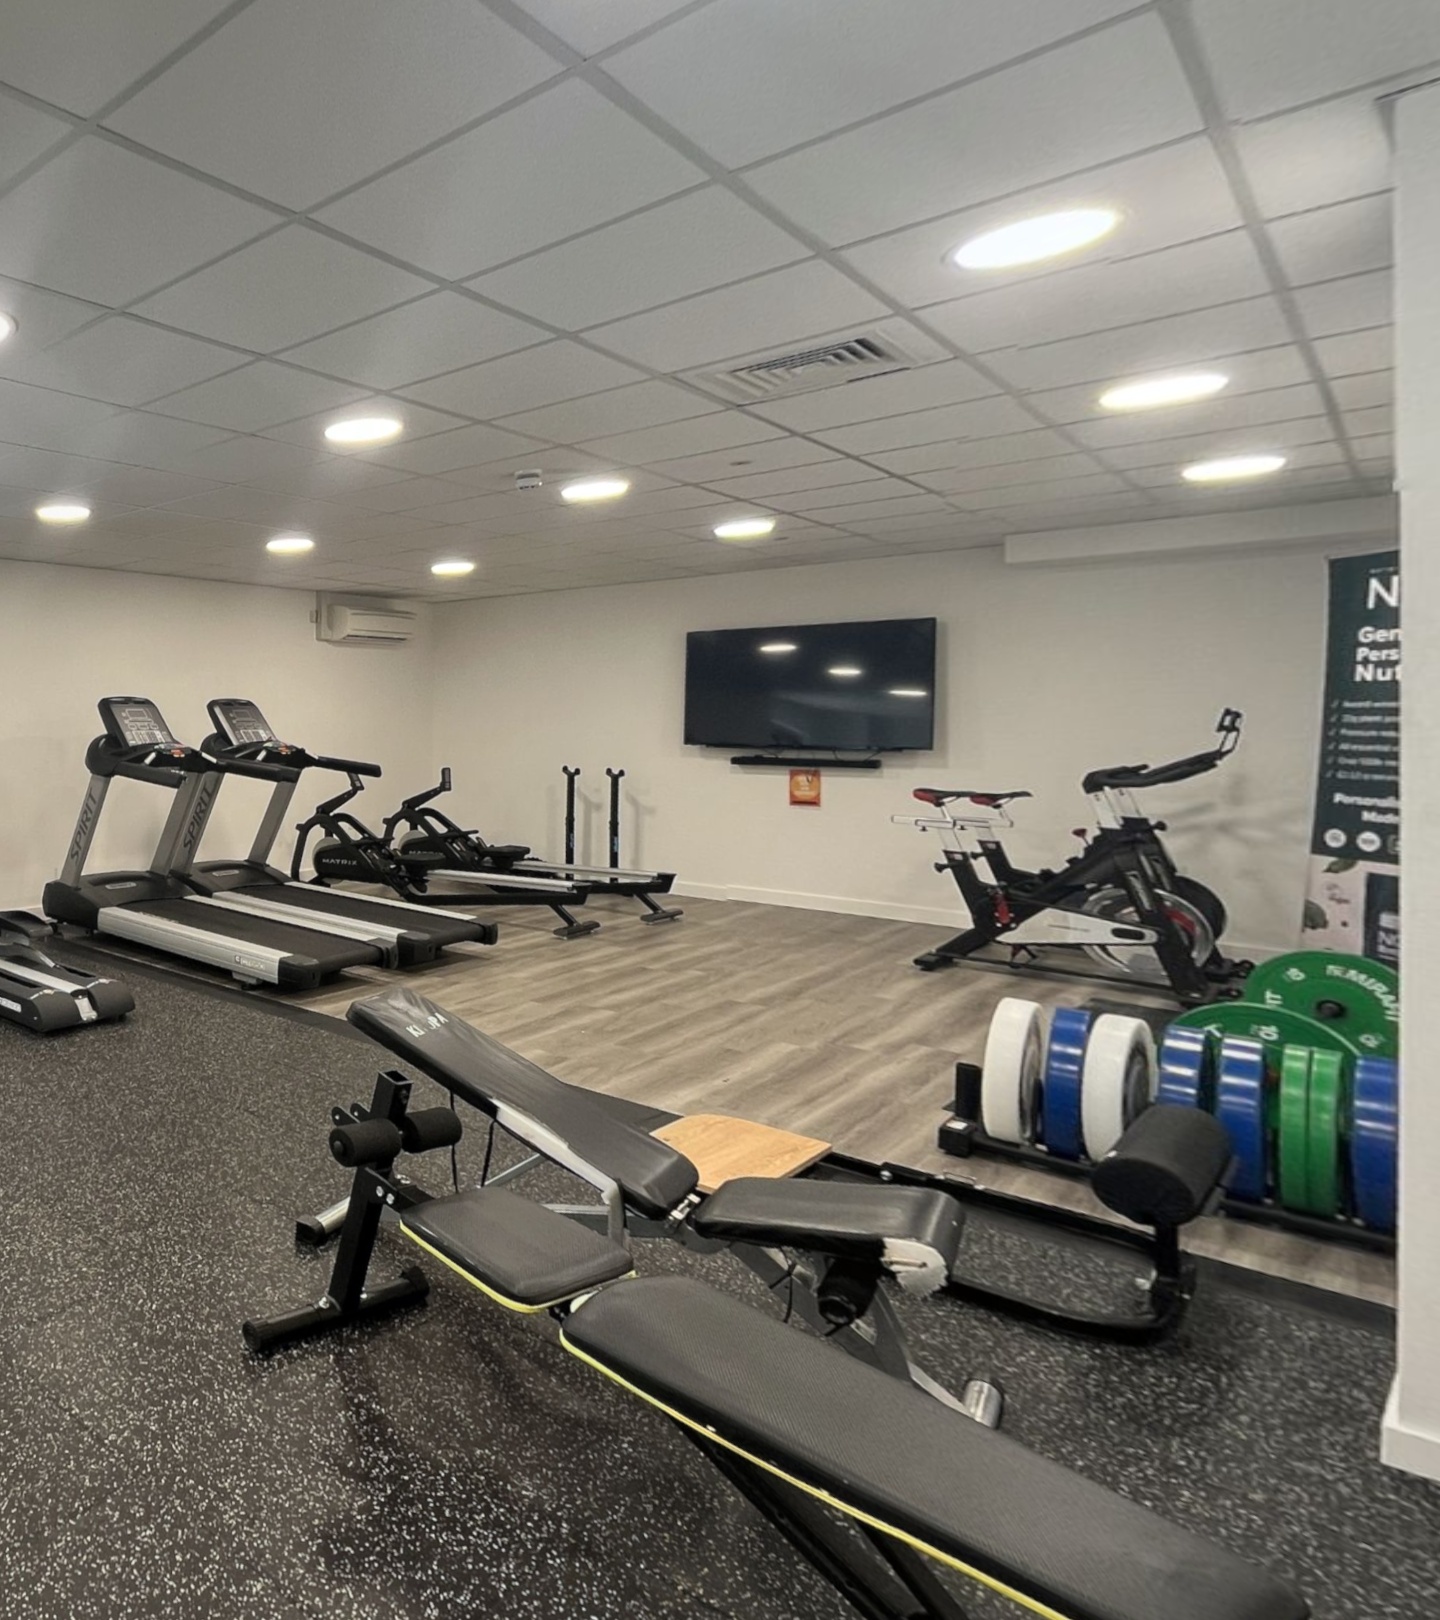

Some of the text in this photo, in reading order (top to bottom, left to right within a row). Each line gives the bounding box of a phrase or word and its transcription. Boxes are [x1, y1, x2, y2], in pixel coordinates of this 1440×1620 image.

[71, 787, 98, 865] SPIRIT
[183, 783, 213, 855] SPIRIT
[322, 858, 358, 866] MATRIX
